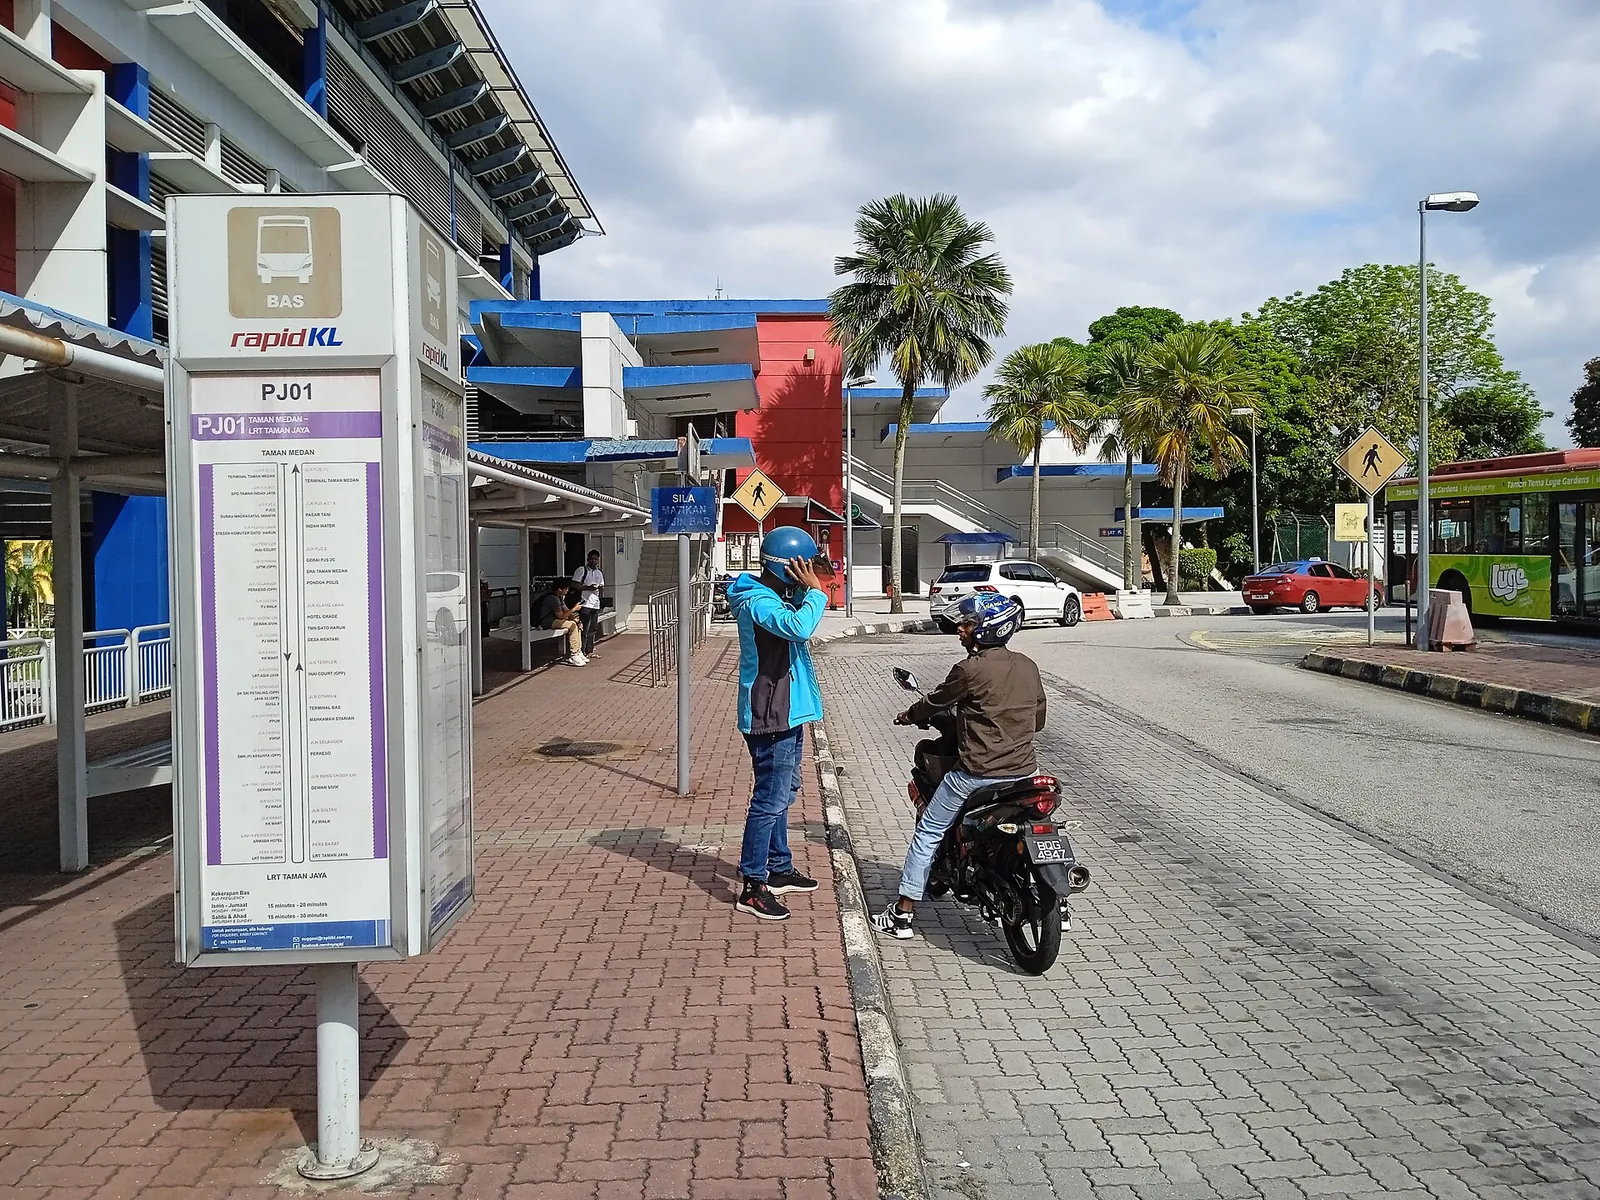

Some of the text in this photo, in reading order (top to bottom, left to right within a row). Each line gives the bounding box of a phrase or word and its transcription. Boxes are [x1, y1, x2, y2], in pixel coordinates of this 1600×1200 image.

[267, 294, 304, 308] BAS
[231, 327, 343, 352] rapidKL
[422, 341, 449, 372] rapidKL
[261, 383, 312, 401] PJ01
[248, 415, 302, 424] TAMAN MEDAN
[198, 416, 245, 435] PJ01
[248, 427, 263, 435] LRT
[291, 426, 310, 434] JAYA
[261, 449, 287, 457] TAMAN
[1528, 479, 1544, 488] Tema
[1545, 478, 1561, 488] Luge
[1562, 476, 1590, 485] Gardens
[1437, 485, 1458, 494] Gardens
[672, 493, 696, 503] SILA
[689, 516, 711, 526] BAS
[1036, 840, 1062, 851] BQG
[1037, 849, 1066, 860] 4947
[309, 872, 327, 880] JAYA
